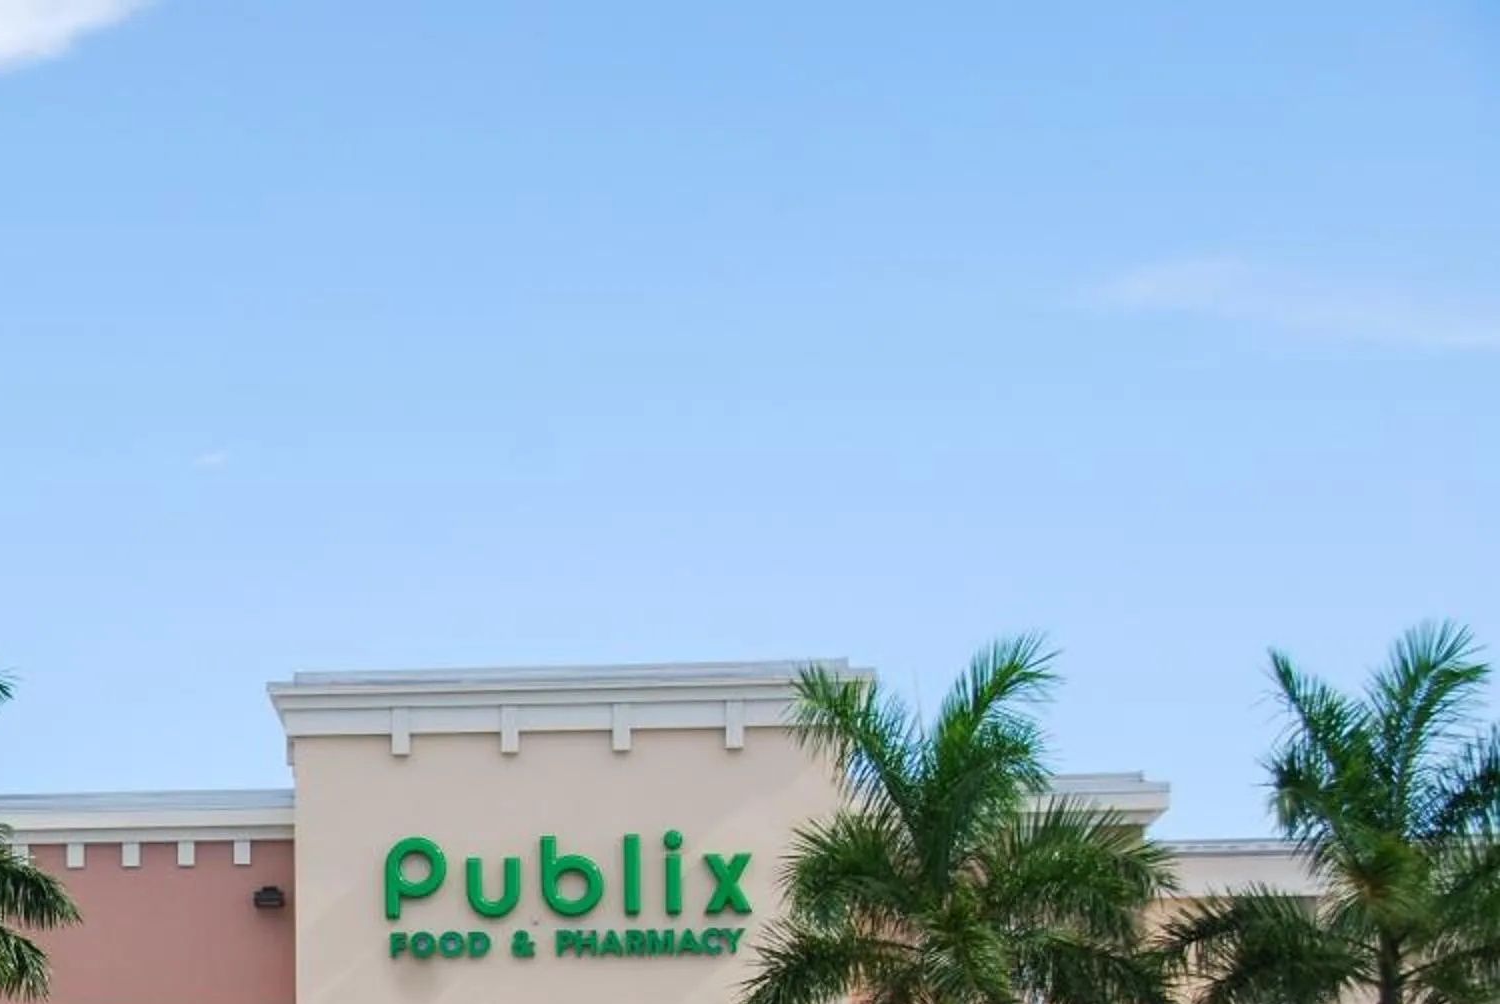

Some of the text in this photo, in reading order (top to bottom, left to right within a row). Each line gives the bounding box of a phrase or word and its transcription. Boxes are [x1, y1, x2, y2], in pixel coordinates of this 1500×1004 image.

[385, 830, 752, 920] Publix
[389, 928, 745, 959] FOOD & PHARMACY
